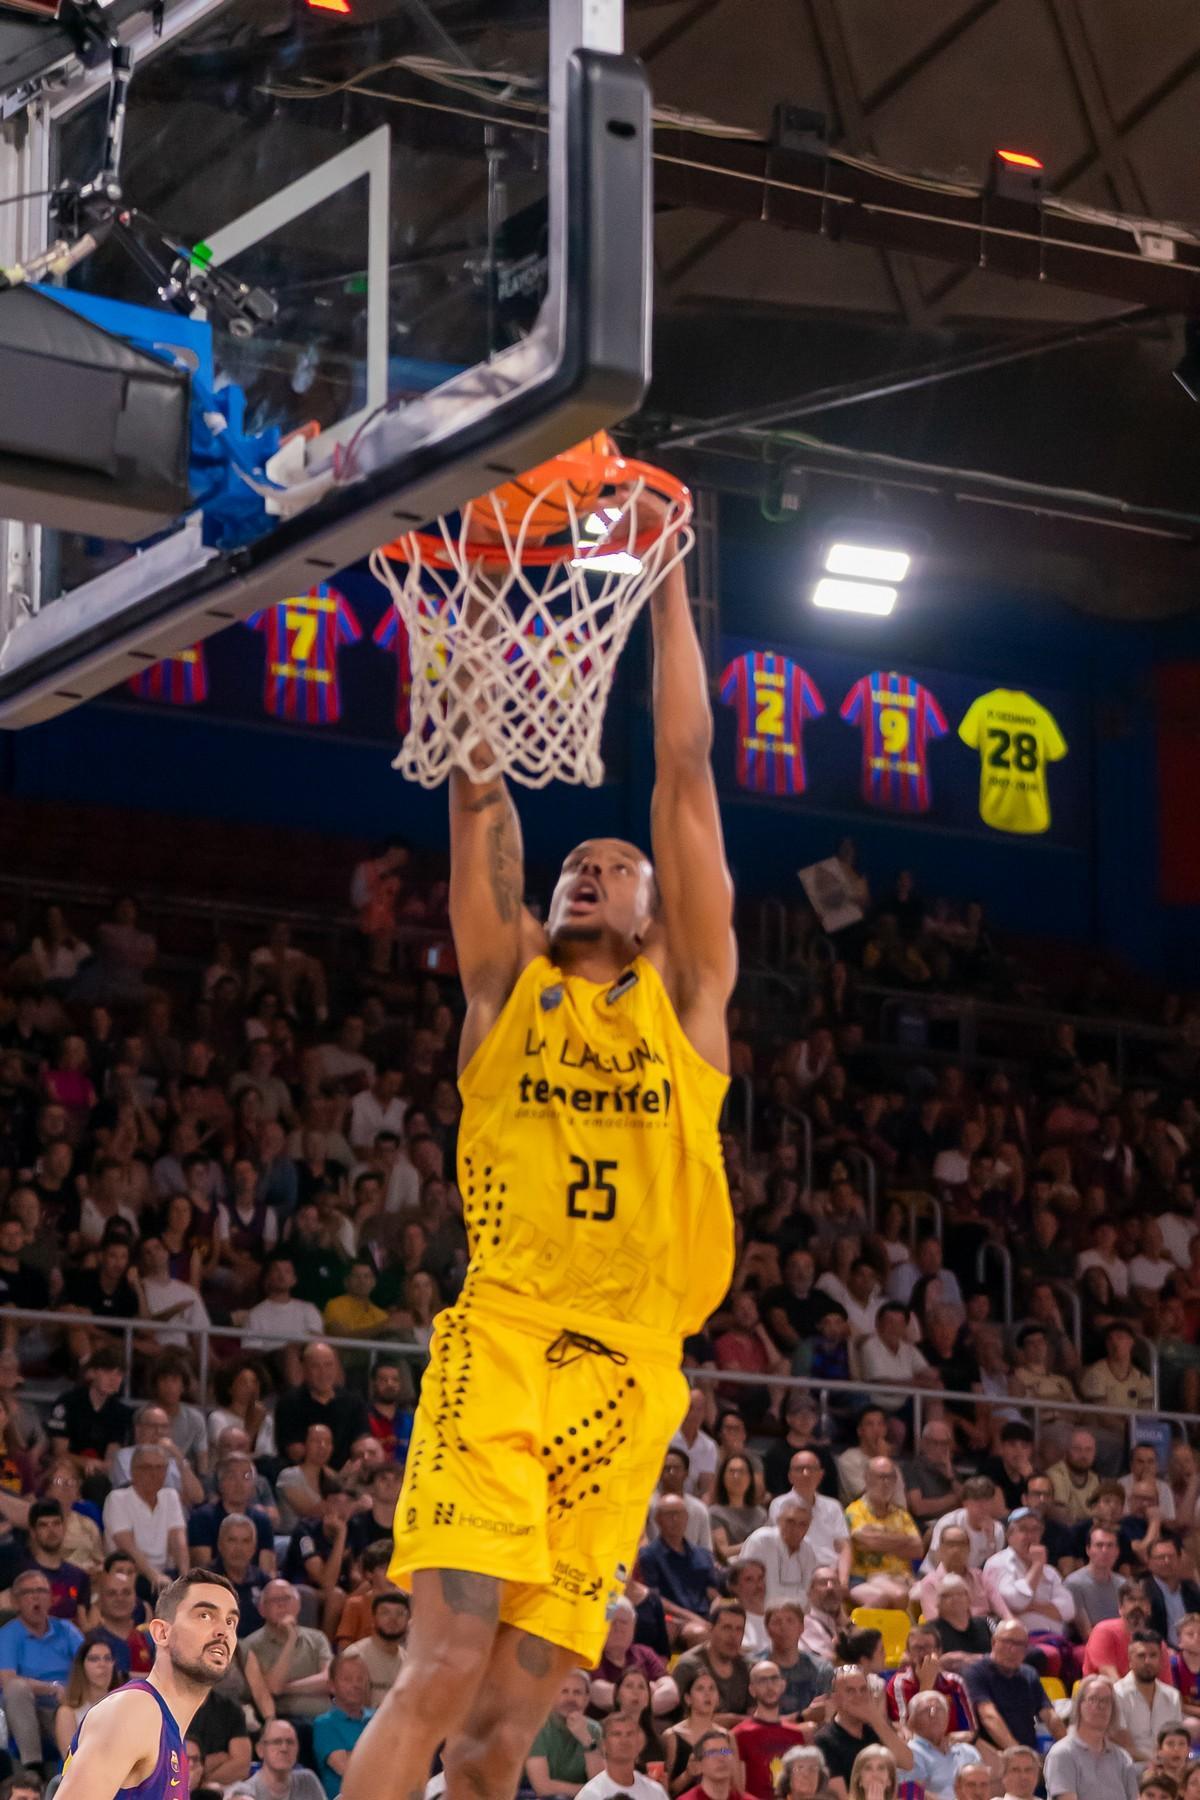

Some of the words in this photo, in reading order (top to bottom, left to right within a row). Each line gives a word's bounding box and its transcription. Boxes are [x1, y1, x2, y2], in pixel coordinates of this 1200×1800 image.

[286, 611, 318, 660] 7
[756, 688, 784, 736] 2
[879, 708, 909, 753] 9
[987, 729, 1038, 773] 28
[567, 1155, 618, 1222] 25
